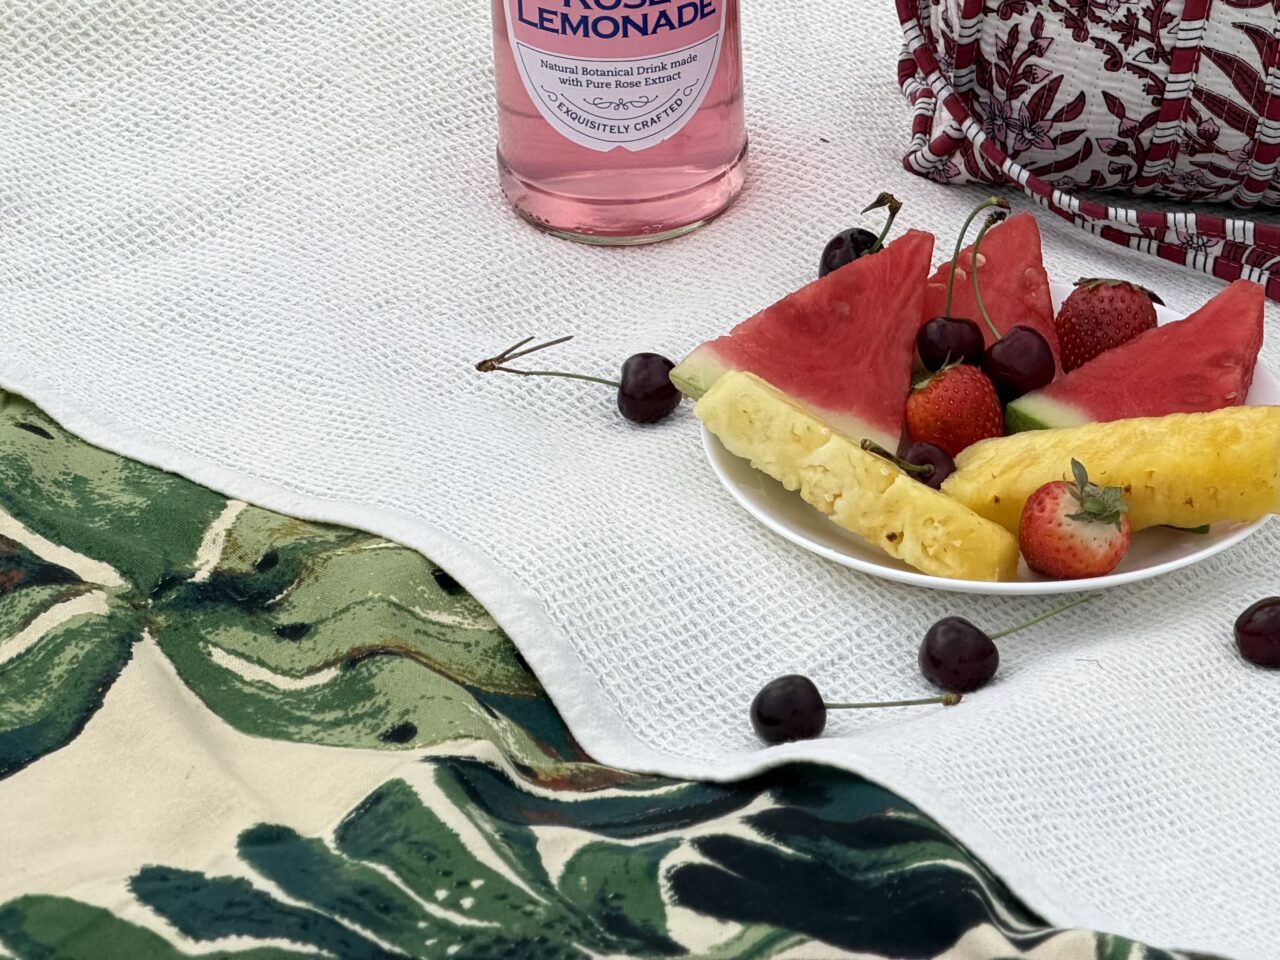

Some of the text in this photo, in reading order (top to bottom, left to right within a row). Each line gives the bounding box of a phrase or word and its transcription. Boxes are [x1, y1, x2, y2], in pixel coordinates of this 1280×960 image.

[540, 53, 698, 77] Natural Botanical Drink made
[558, 71, 682, 89] with Pure Rose Extract
[557, 98, 683, 134] EXQUISITELY CRAFTED
